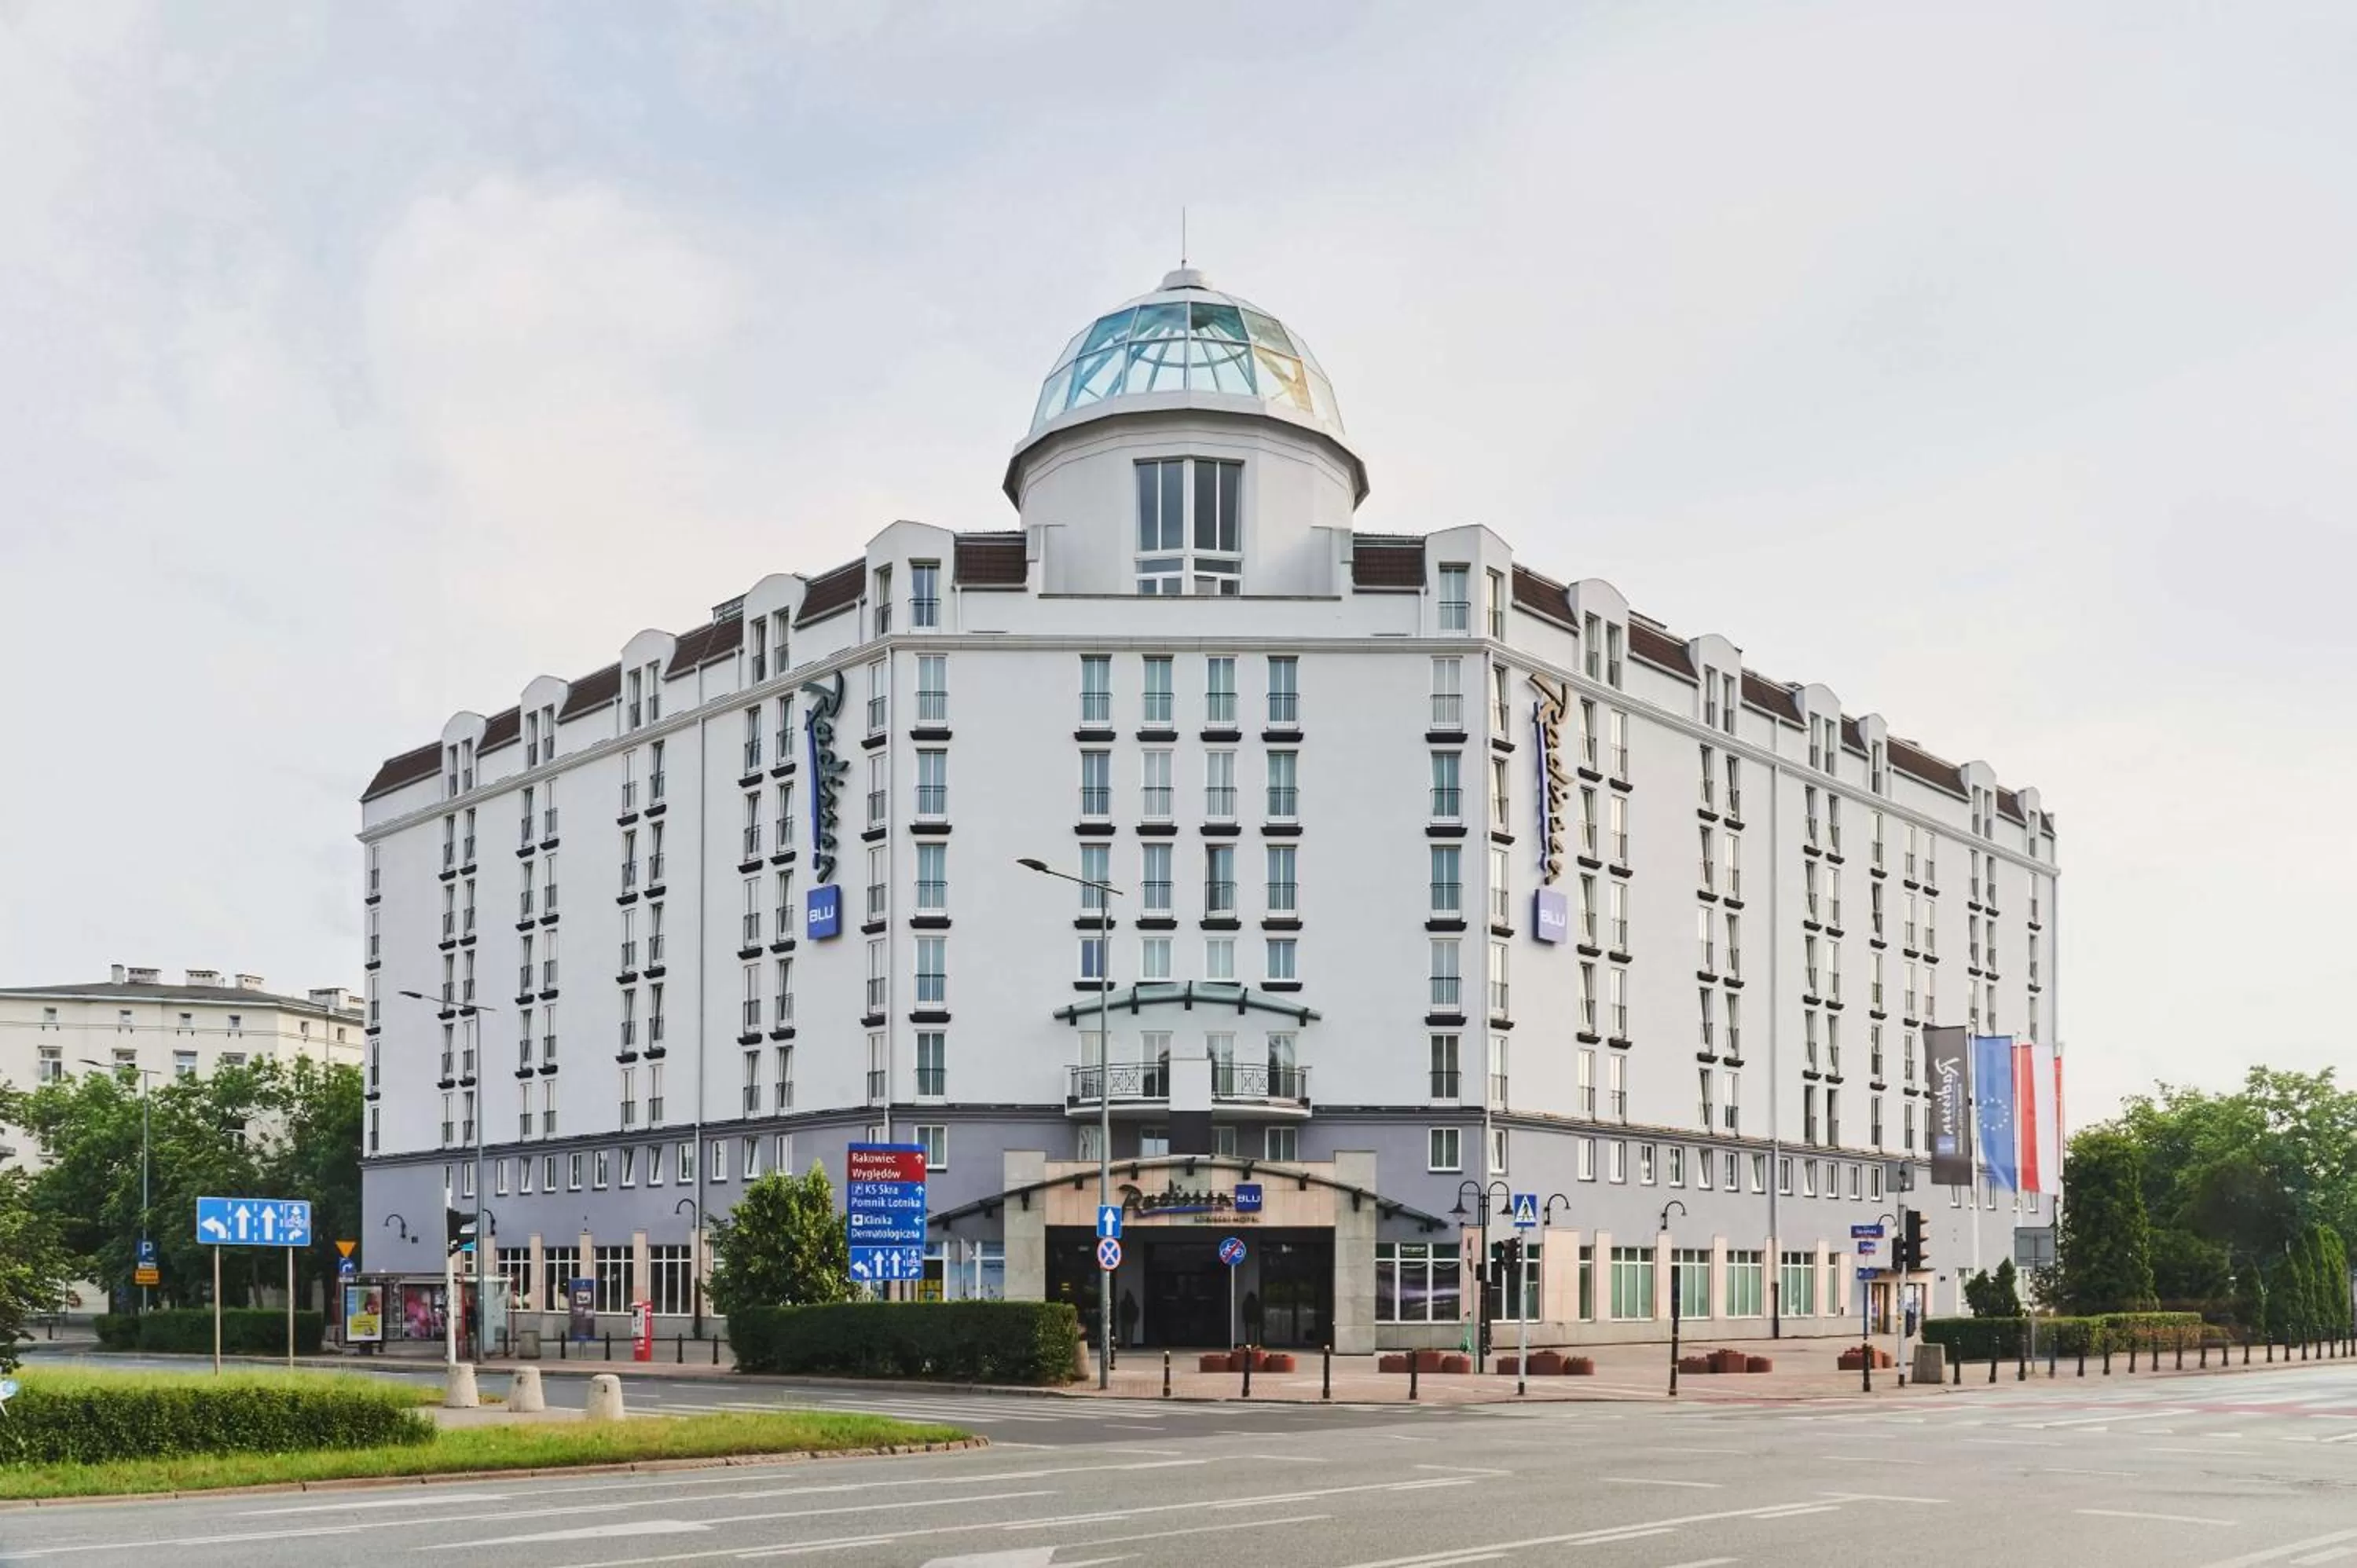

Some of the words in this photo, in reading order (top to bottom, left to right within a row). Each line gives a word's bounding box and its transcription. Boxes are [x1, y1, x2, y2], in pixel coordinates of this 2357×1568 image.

[800, 670, 849, 883] Radisson
[1529, 673, 1575, 885] Radisson
[808, 904, 834, 923] BLU
[1540, 909, 1565, 928] BLU
[852, 1152, 896, 1163] Rakowiec
[852, 1168, 901, 1181] Wyględów
[865, 1185, 877, 1195] KS
[879, 1184, 899, 1195] Skra
[852, 1196, 885, 1207] Pomnik
[888, 1196, 922, 1207] Lotnika
[1119, 1178, 1233, 1221] Radisson
[1237, 1194, 1261, 1203] BLU
[864, 1214, 893, 1225] Klinika
[851, 1228, 920, 1242] Dermatologiczna
